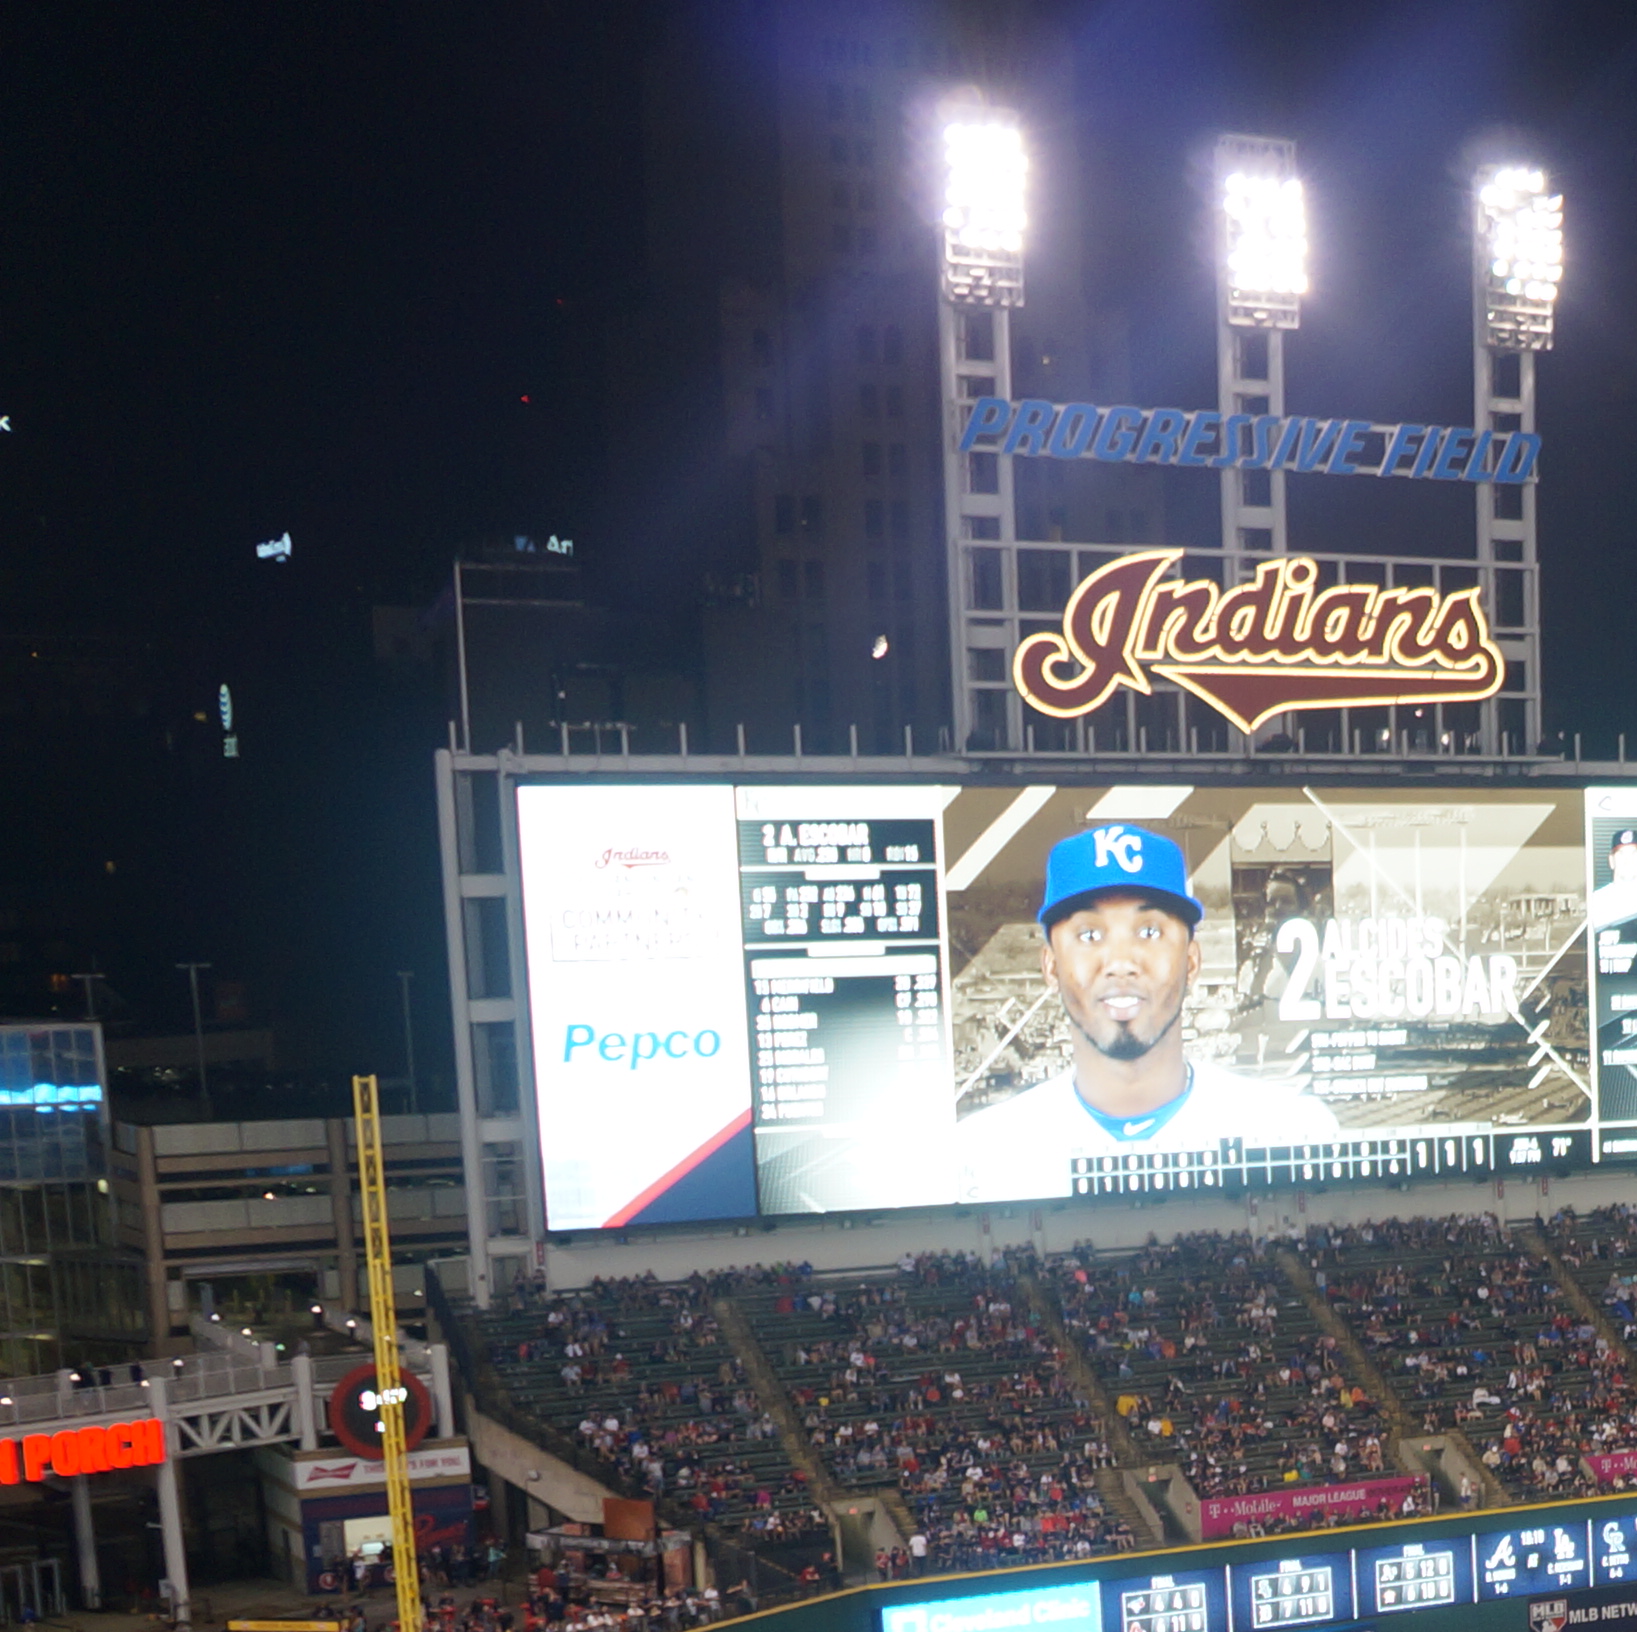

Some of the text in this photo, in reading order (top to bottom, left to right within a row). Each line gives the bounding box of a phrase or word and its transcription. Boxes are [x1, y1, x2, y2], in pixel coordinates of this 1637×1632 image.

[961, 397, 1542, 483] PROGRESSIVE FIELD
[1013, 548, 1506, 734] Indians
[798, 822, 869, 847] ESCOBAR
[1094, 825, 1142, 873] KC
[1276, 917, 1444, 1022] 2 ALCIDES
[1325, 954, 1518, 1019] ESCOBAR
[563, 1024, 722, 1070] Pepco
[23, 1418, 165, 1482] PORCH
[1292, 1494, 1326, 1508] MAJOR
[1327, 1488, 1366, 1504] LEAGUE
[1032, 1598, 1091, 1623] Clinic
[1530, 1601, 1565, 1620] MLB
[1569, 1605, 1602, 1625] MLB
